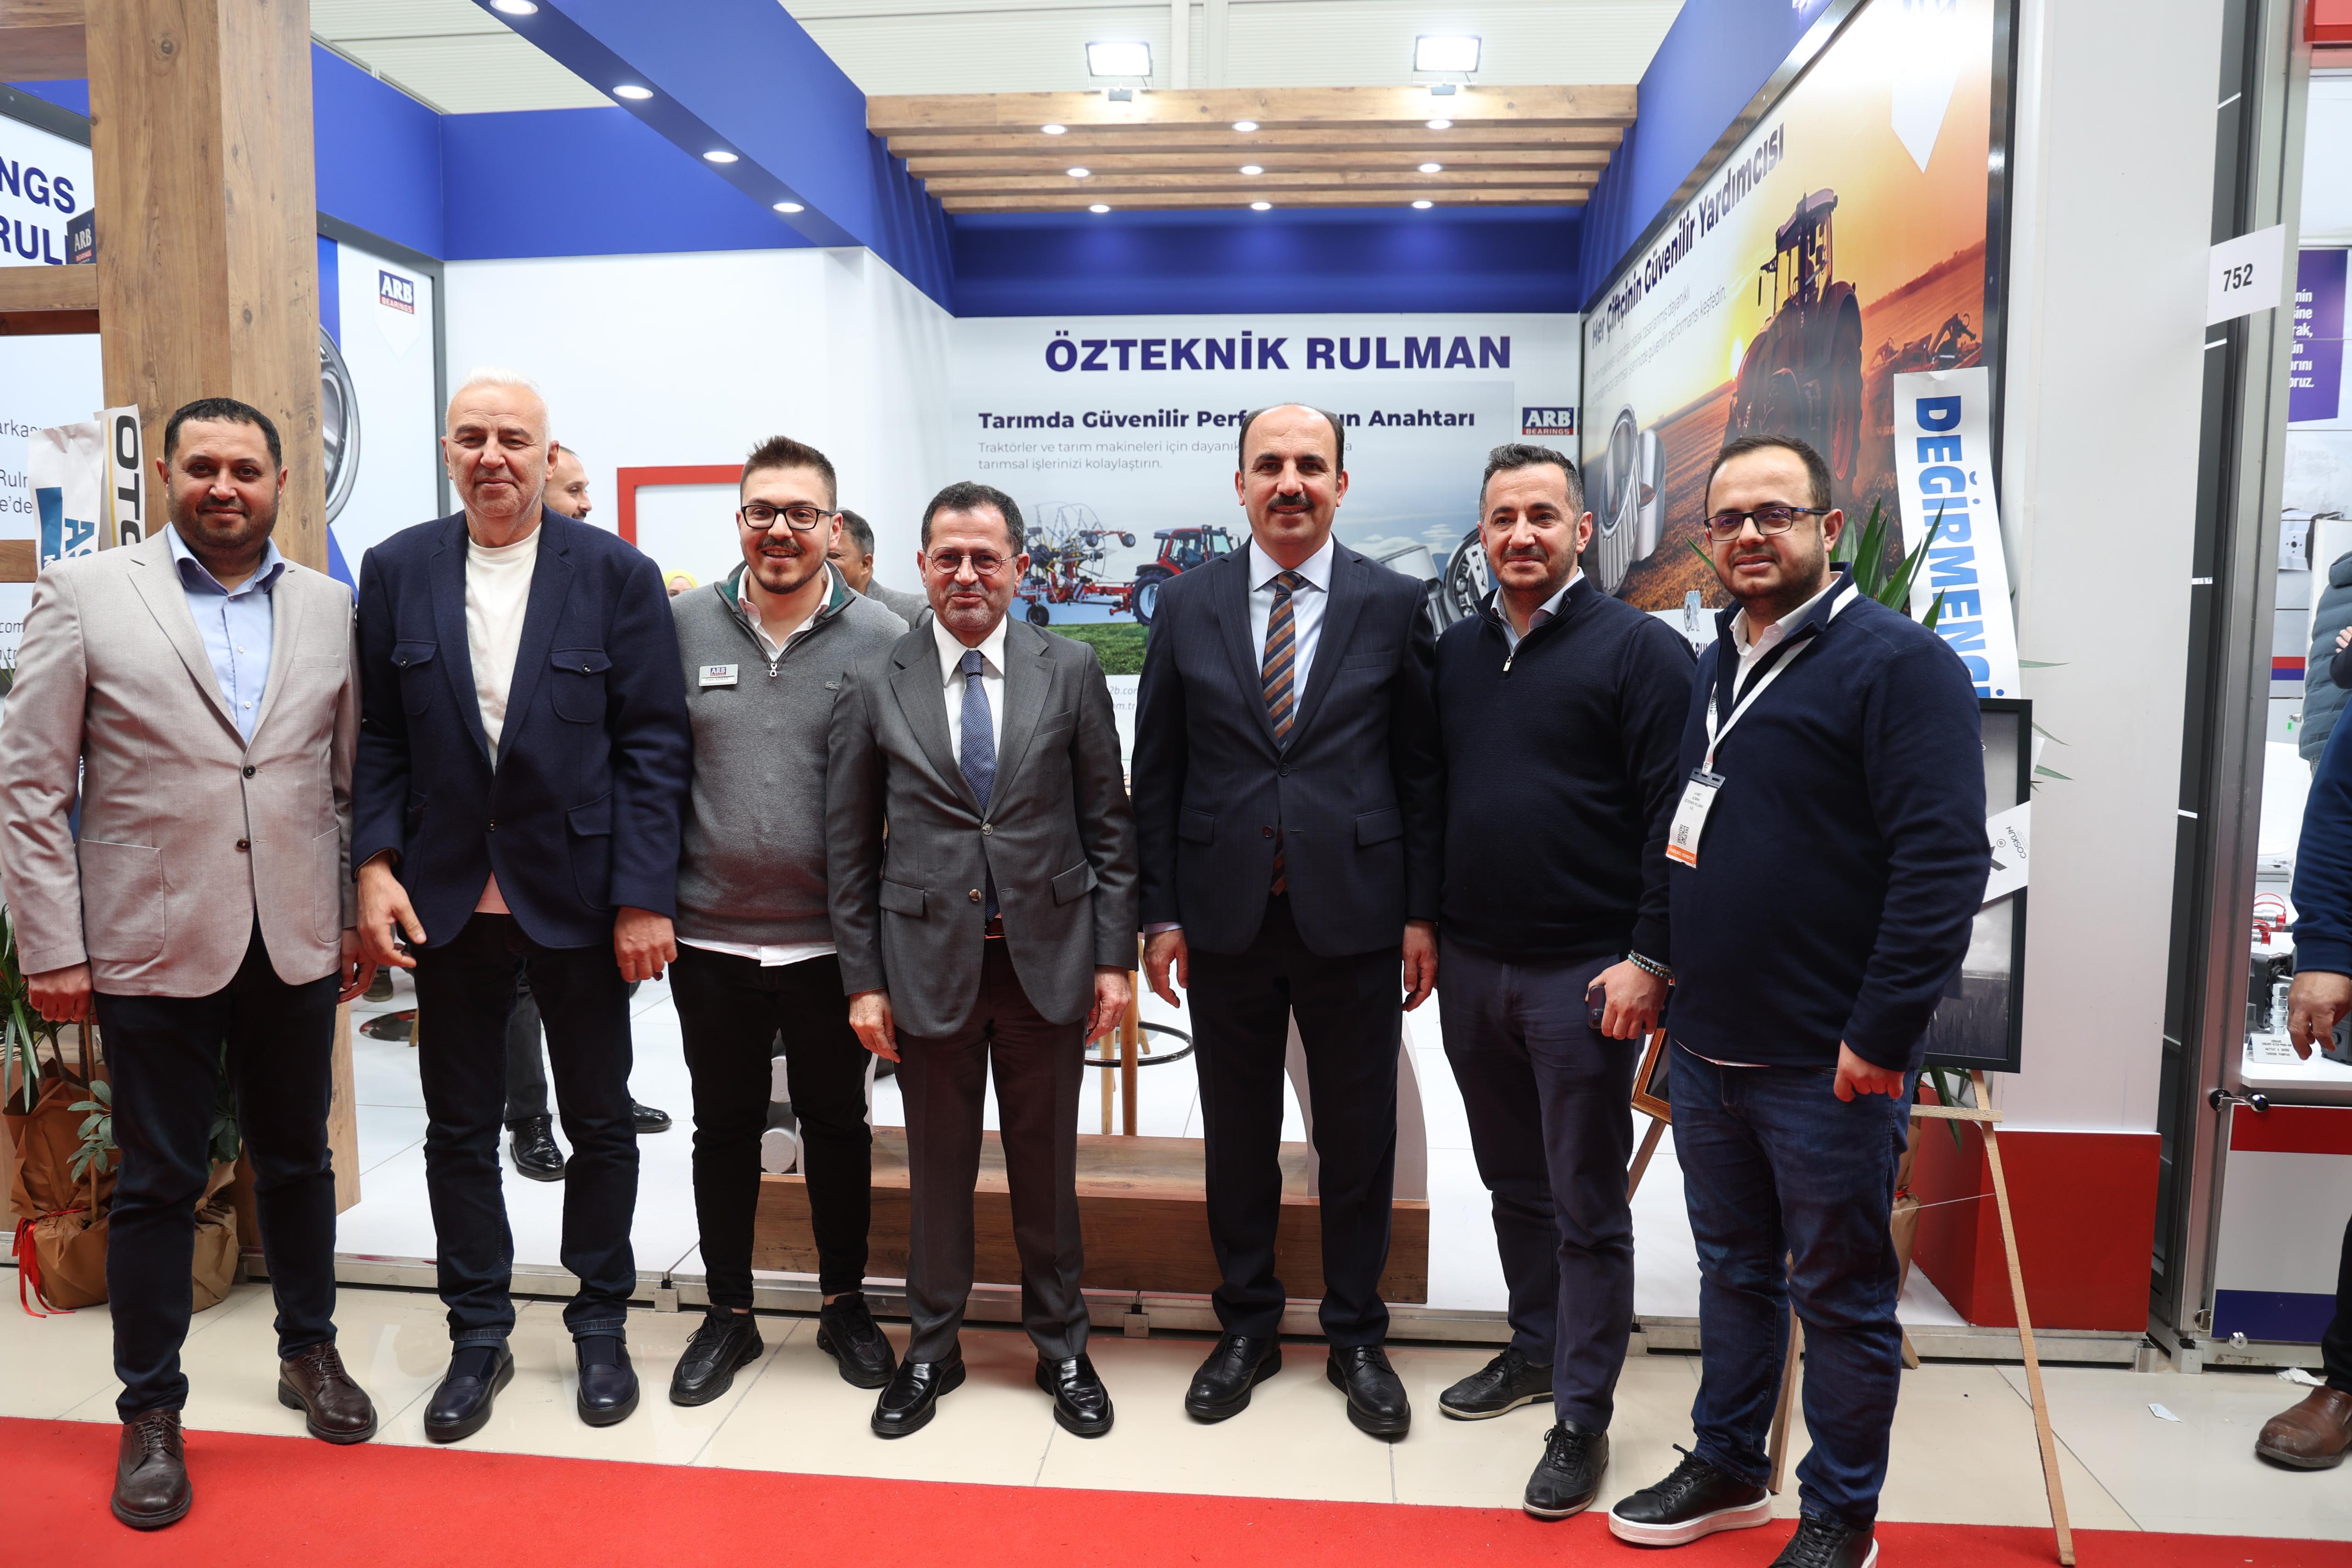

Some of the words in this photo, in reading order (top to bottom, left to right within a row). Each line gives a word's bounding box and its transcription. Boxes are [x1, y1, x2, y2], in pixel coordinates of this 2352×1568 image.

[0, 156, 75, 214] NGS
[0, 215, 68, 265] RUL
[74, 228, 92, 252] ARB
[1593, 316, 1605, 349] Her
[1607, 270, 1641, 343] Çiftçinin
[1645, 211, 1696, 294] Güvenilir
[1699, 122, 1785, 238] Yardımcısı
[381, 275, 413, 304] ARB
[2223, 263, 2253, 292] 752
[382, 296, 412, 313] BEARINGS
[1668, 307, 1699, 347] performansı
[1700, 284, 1726, 318] keşfedin.
[2293, 305, 2312, 319] ine
[1045, 330, 1289, 372] ÖZTEKNİK
[1306, 336, 1510, 369] RULMAN
[978, 412, 1074, 429] Tarımda
[1082, 409, 1189, 428] Güvenilir
[1197, 409, 1247, 427] Perf
[1339, 414, 1360, 427] ın
[1368, 409, 1475, 427] Anahtarı
[1525, 410, 1571, 427] ARB
[978, 442, 1037, 452] Traktörler
[1040, 444, 1055, 452] ve
[1058, 443, 1091, 452] tarım
[1096, 440, 1162, 452] makineleri
[1166, 440, 1187, 454] için
[1192, 440, 1239, 454] dayanık
[978, 459, 1028, 469] tarımsal
[1032, 458, 1081, 471] işlerinizi
[1086, 457, 1163, 471] kolaylaştırın.
